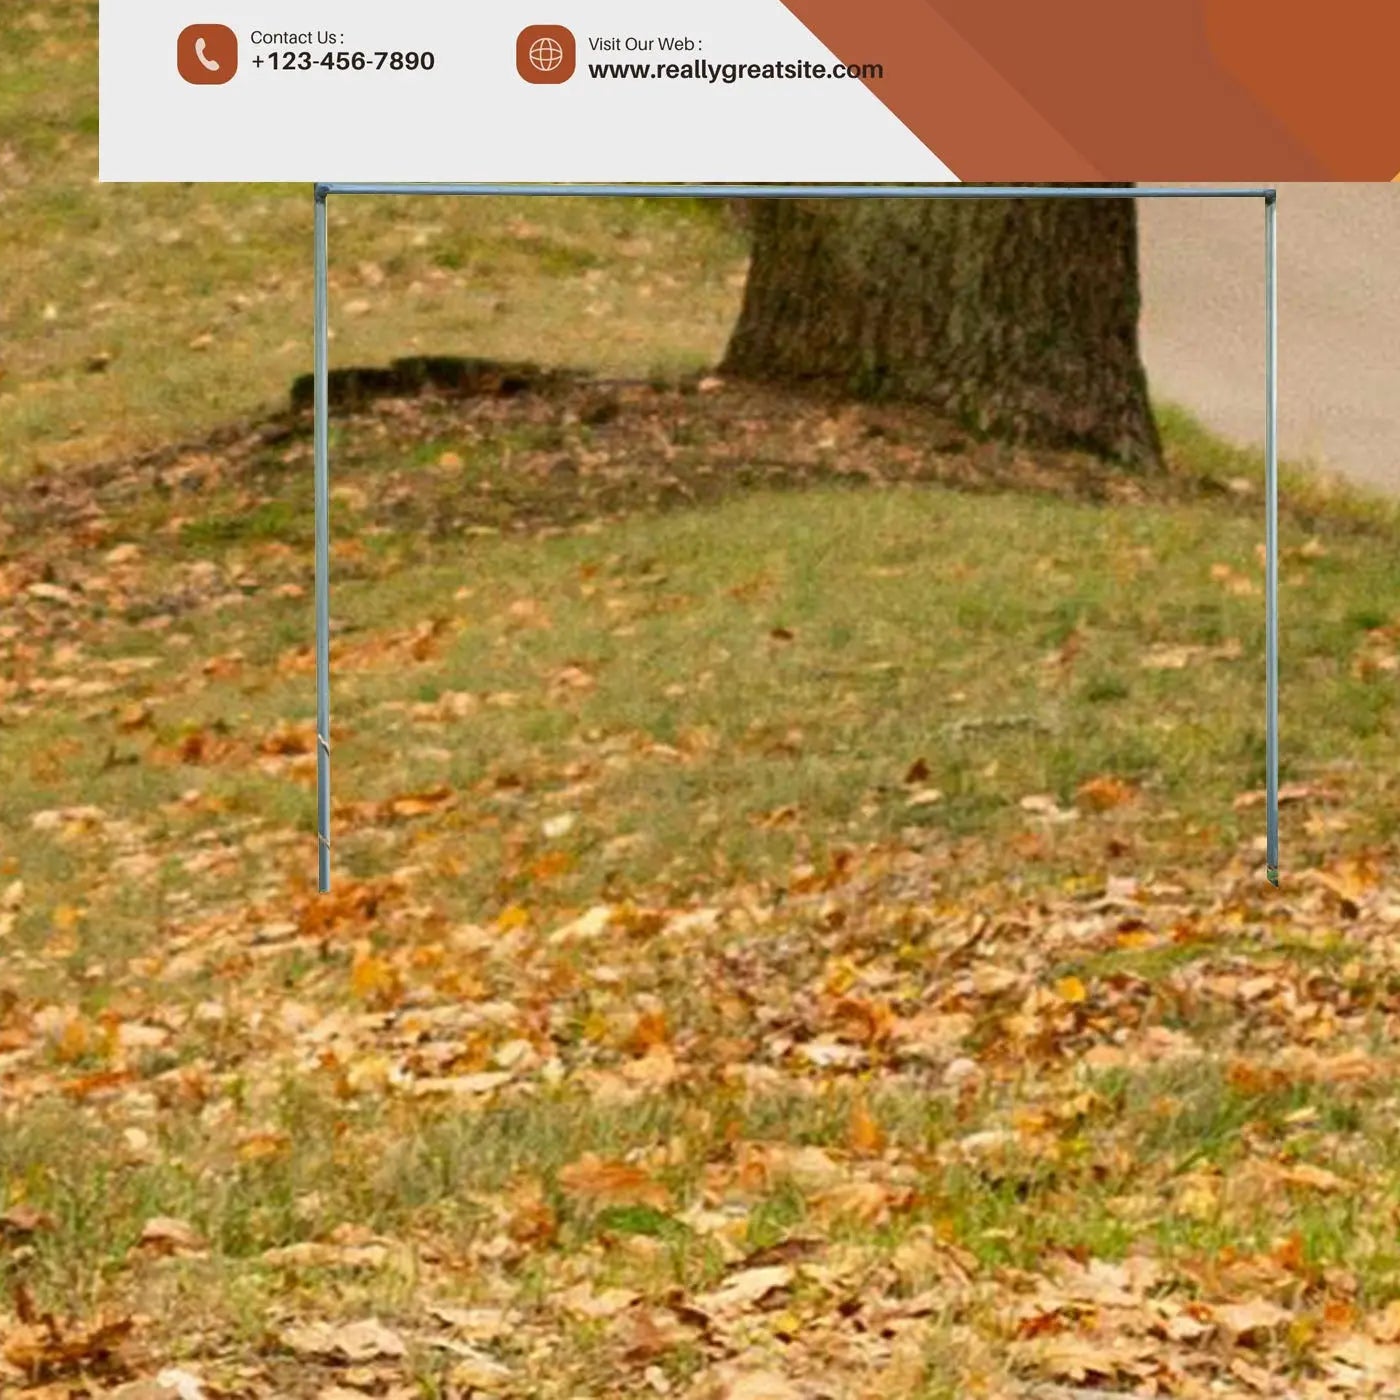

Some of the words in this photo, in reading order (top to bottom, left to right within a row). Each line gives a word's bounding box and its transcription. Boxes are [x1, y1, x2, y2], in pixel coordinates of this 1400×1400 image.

[251, 31, 312, 44] Contact
[589, 37, 621, 51] Visit
[625, 37, 654, 51] Our
[252, 52, 434, 70] +123-456-7890
[588, 59, 883, 84] www.reallygreatsite.com
